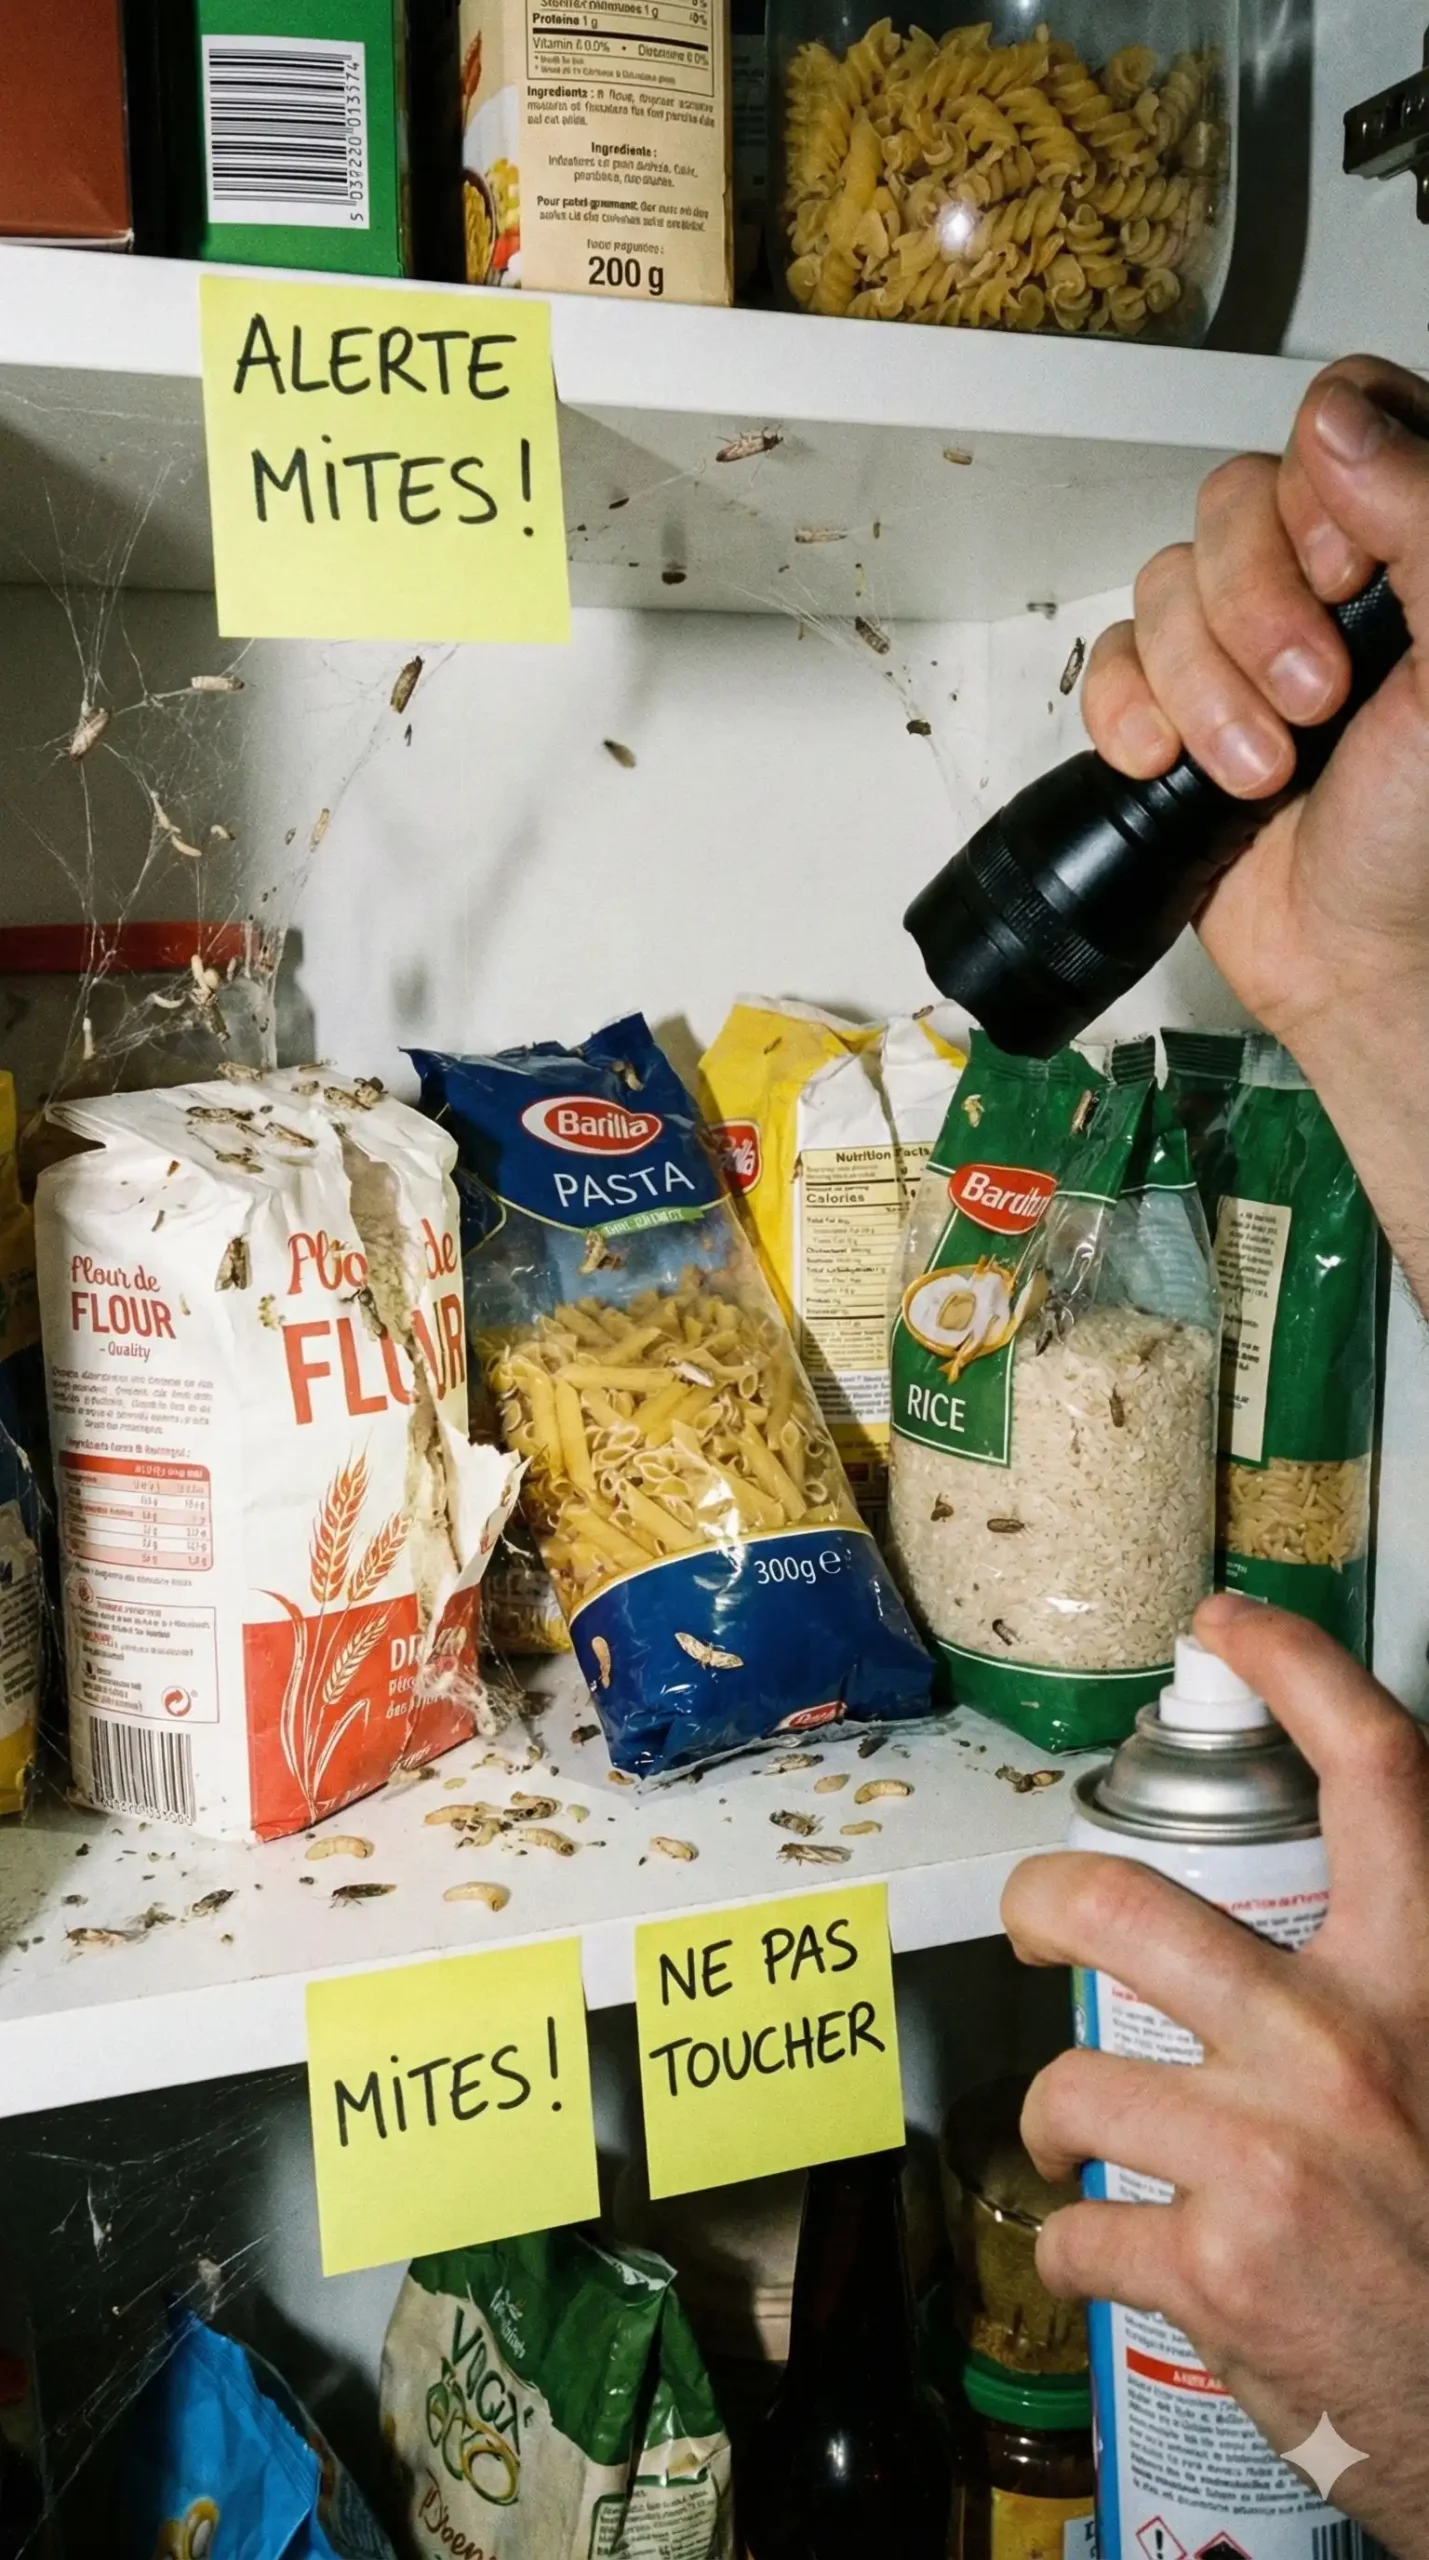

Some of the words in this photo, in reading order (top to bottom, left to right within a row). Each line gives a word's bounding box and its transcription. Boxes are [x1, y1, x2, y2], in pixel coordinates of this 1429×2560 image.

[591, 17, 599, 29] g
[588, 256, 641, 287] 200
[648, 265, 664, 296] g
[233, 313, 517, 401] ALERTE
[557, 1109, 650, 1139] Barilla
[836, 1149, 891, 1162] Nutrition
[553, 1160, 696, 1208] PASTA
[806, 1192, 866, 1204] Calories
[134, 1265, 161, 1292] de
[71, 1291, 177, 1340] FLOUR
[108, 1341, 151, 1363] Quality
[907, 1384, 966, 1433] RICE
[754, 1556, 817, 1585] 300g
[659, 1939, 733, 2006] NE
[761, 1919, 859, 1985] PAS
[649, 2000, 886, 2097] TOUCHER
